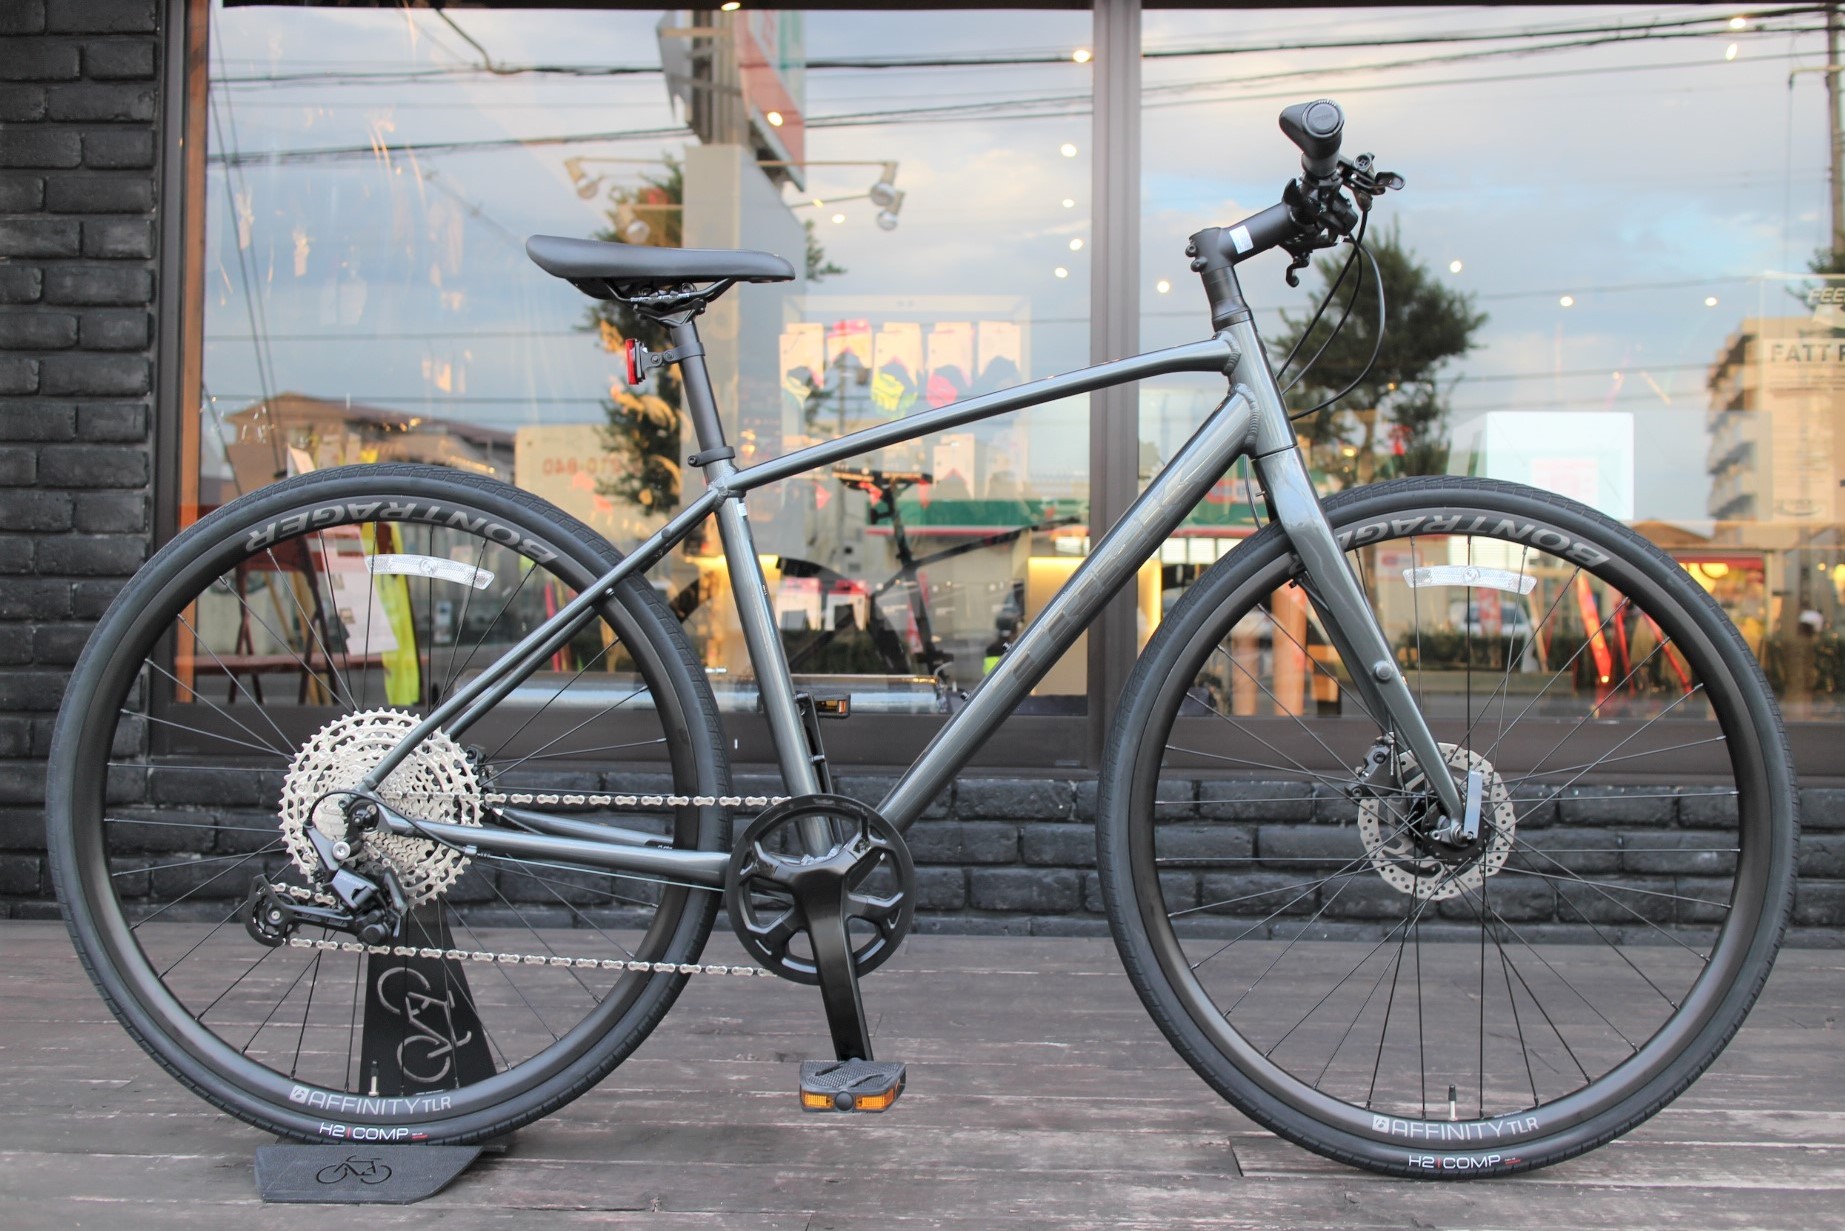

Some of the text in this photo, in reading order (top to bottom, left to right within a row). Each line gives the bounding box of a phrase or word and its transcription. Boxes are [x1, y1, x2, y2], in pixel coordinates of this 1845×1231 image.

[245, 501, 559, 563] BONTRAGER
[307, 1090, 421, 1116] AFFINITY
[421, 1096, 452, 1113] TLR
[318, 1122, 345, 1138] H2
[352, 1126, 409, 1141] COMP
[1391, 1116, 1540, 1141] AFFINITY TLR
[1408, 1154, 1435, 1169] H2
[1442, 1153, 1501, 1170] COMP
